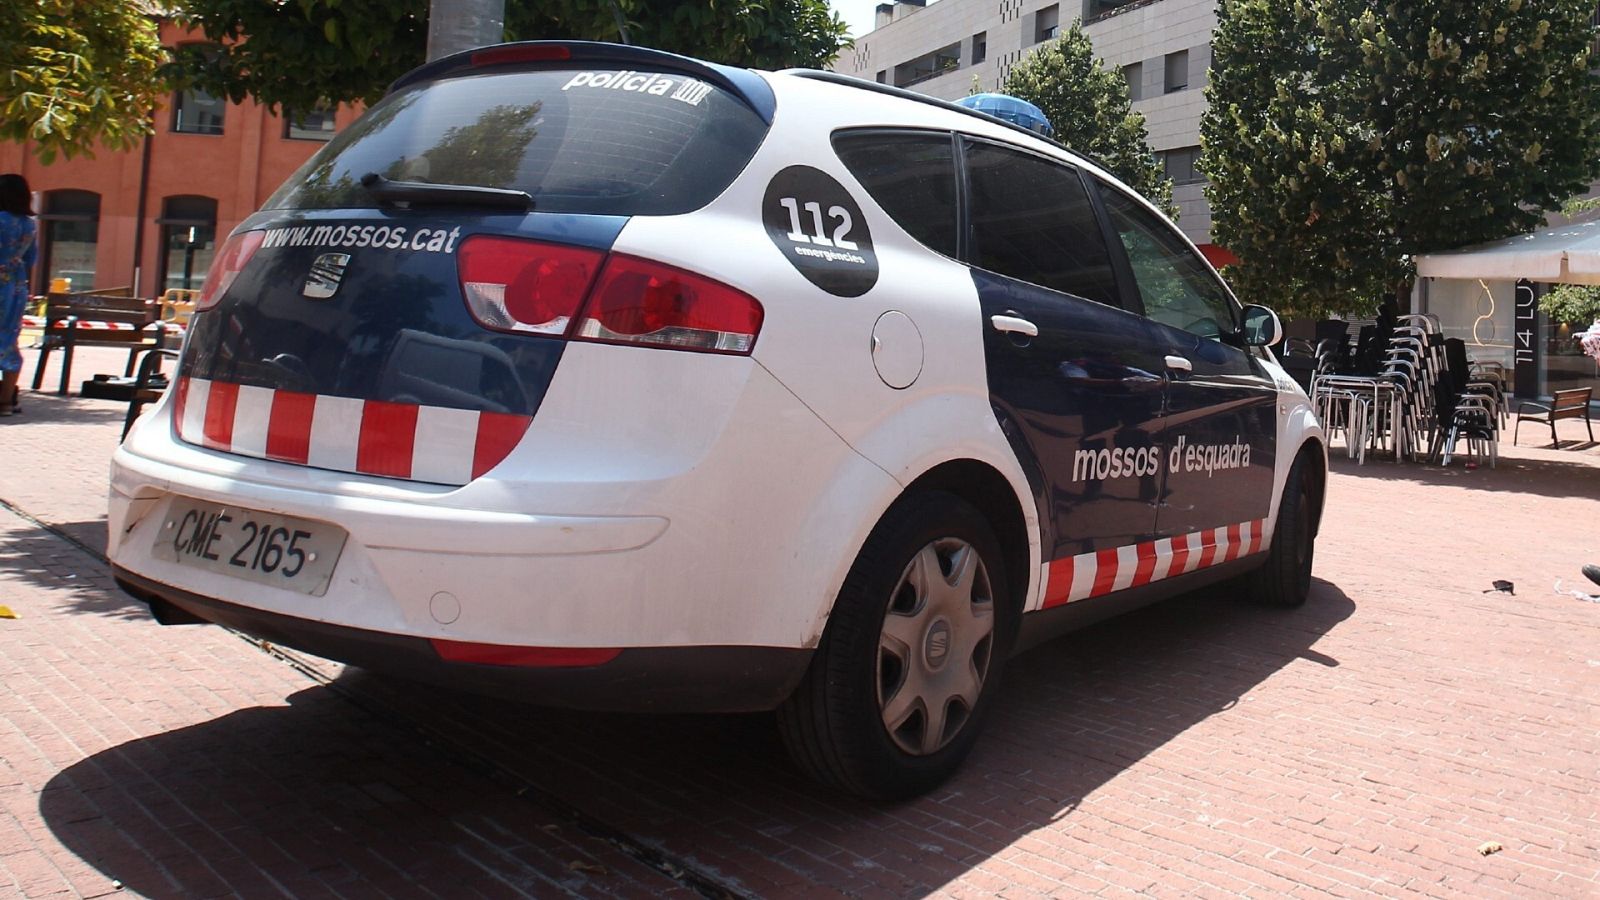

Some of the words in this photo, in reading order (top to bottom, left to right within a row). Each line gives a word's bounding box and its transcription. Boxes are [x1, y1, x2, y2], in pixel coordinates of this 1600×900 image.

[561, 70, 674, 96] policia
[261, 225, 461, 254] www.mossos.cat
[780, 197, 859, 251] 112
[1516, 329, 1534, 365] 114
[1072, 446, 1159, 482] mossos
[1169, 434, 1251, 478] d'esquadra
[174, 509, 233, 561] CME
[229, 520, 312, 578] 2165
